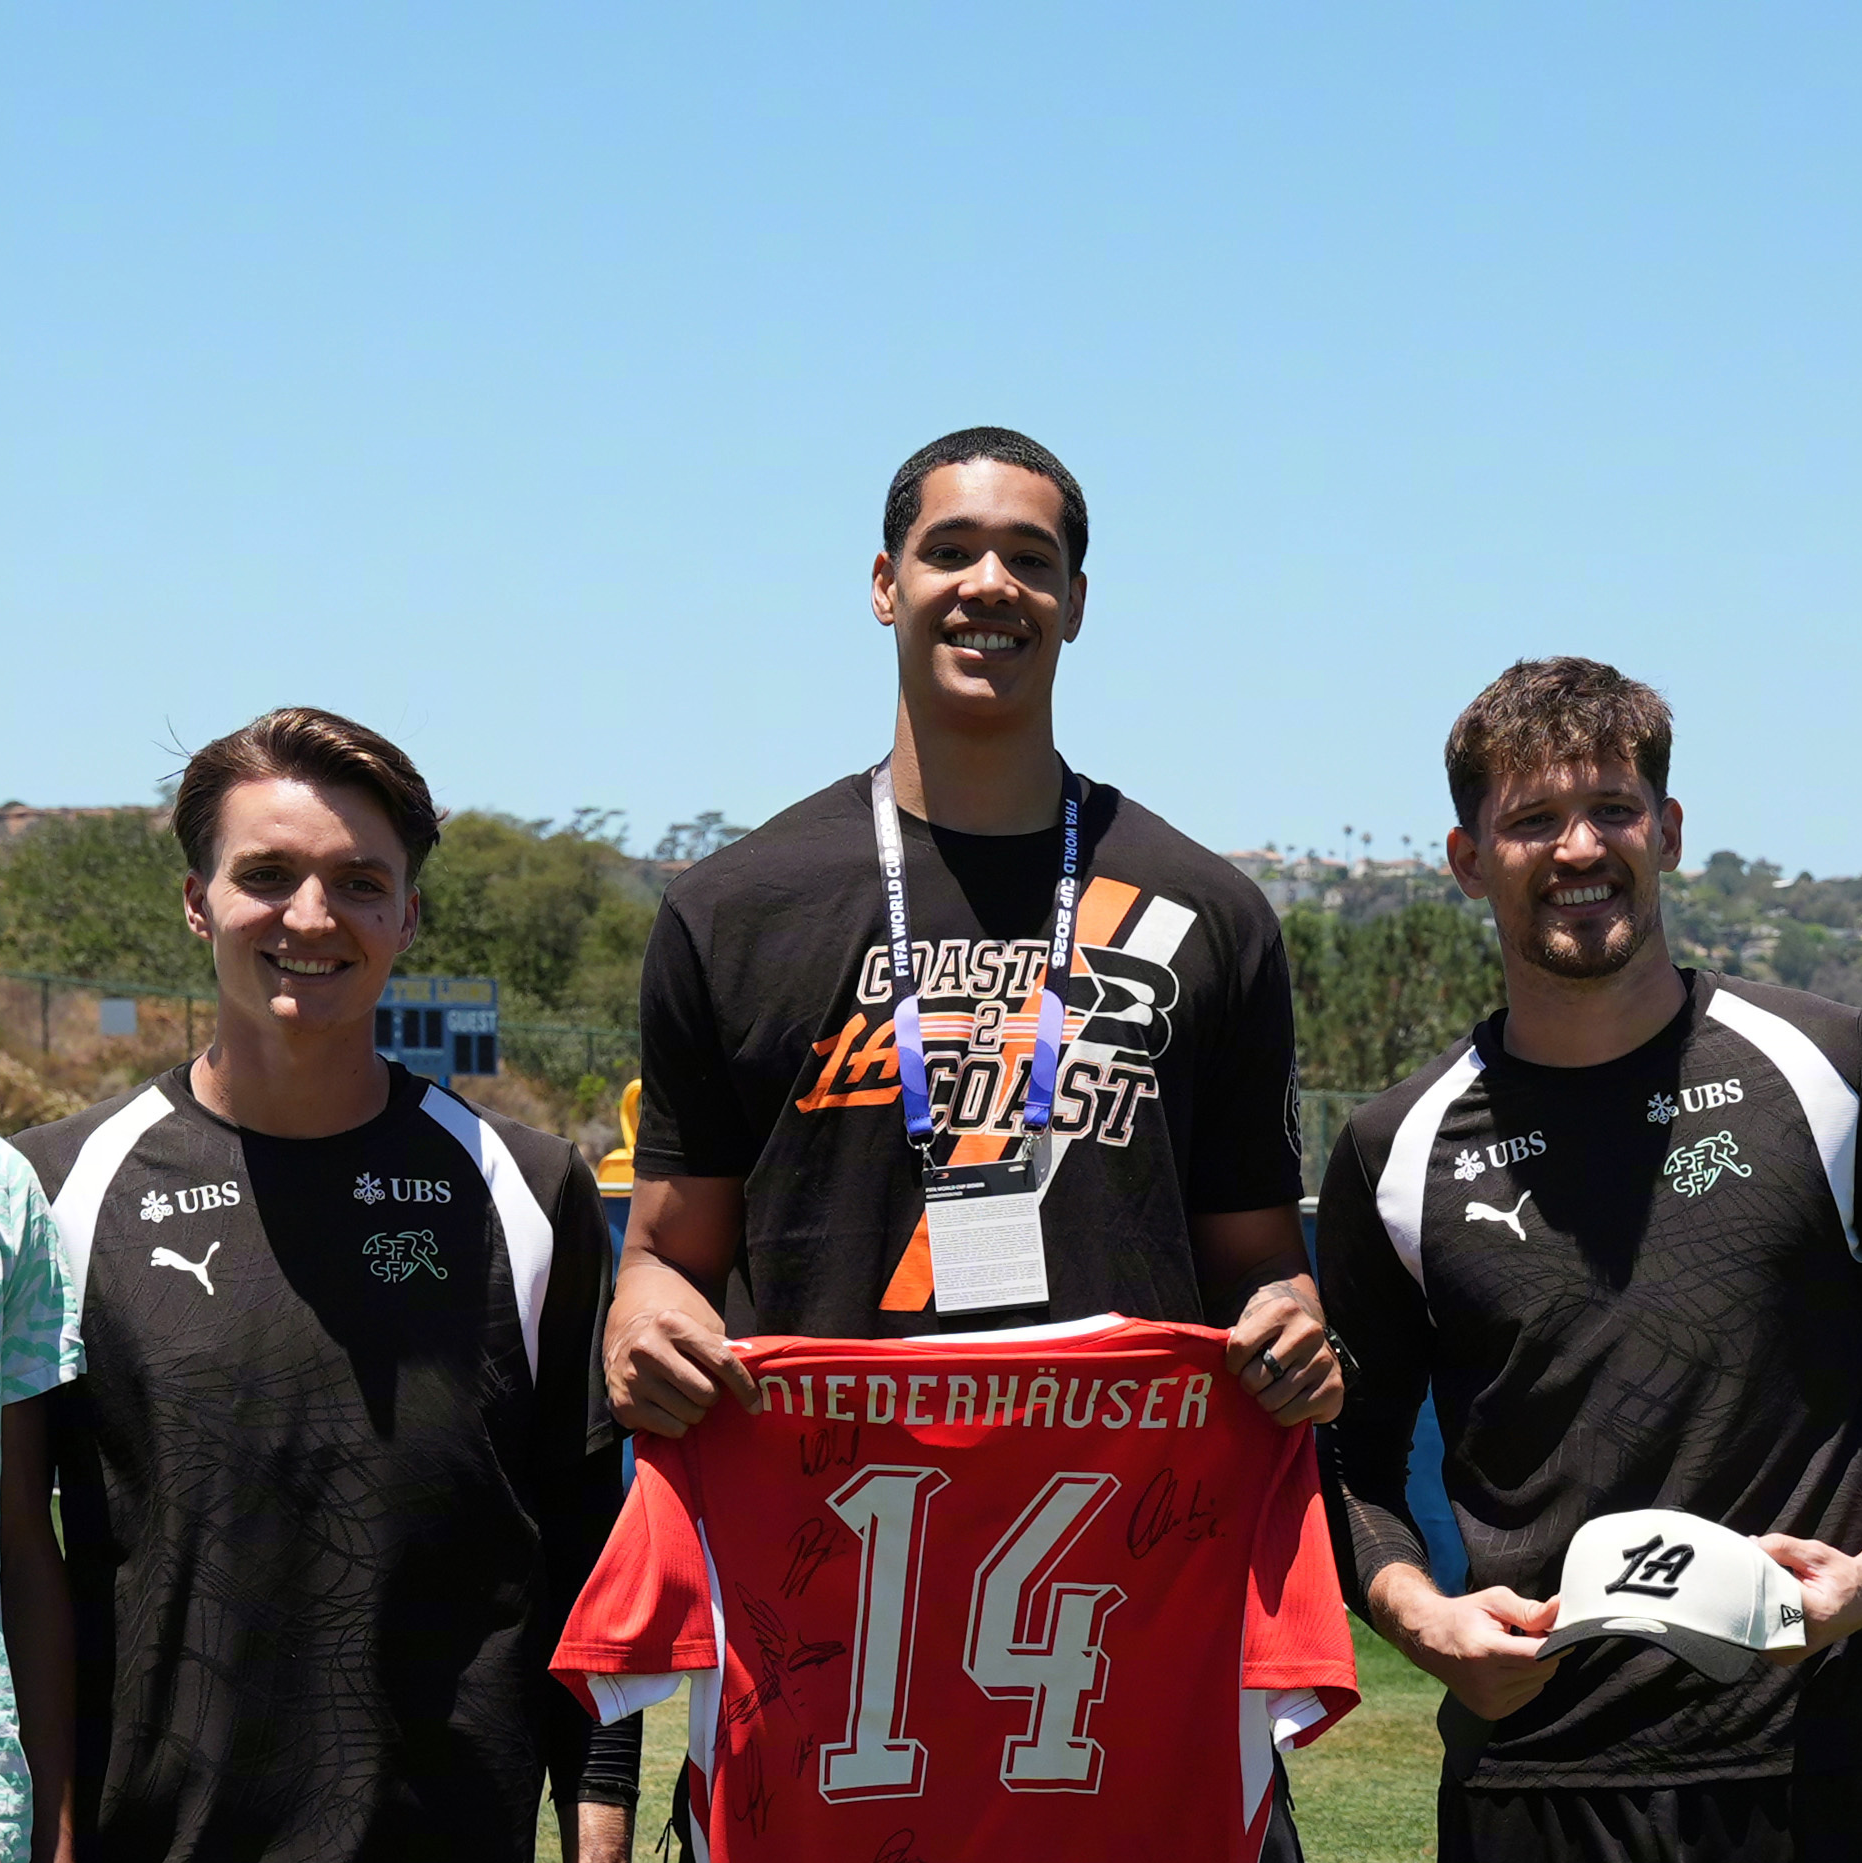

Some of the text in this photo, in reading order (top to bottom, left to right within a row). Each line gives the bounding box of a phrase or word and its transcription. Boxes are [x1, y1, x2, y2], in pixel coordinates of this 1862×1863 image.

[1051, 799, 1079, 967] FIFA WORLD CUP 2026
[887, 880, 907, 938] WORLD
[892, 938, 909, 977] FIFA
[446, 1009, 496, 1033] GUEST
[968, 1000, 1009, 1053] 2
[1680, 1078, 1744, 1112] UBS
[1485, 1130, 1548, 1168] UBS
[174, 1181, 241, 1214] UBS
[389, 1178, 452, 1203] UBS
[759, 1367, 1214, 1430] NIEDERHÄUSER
[1604, 1533, 1695, 1600] LA
[818, 1463, 1128, 1804] 14
